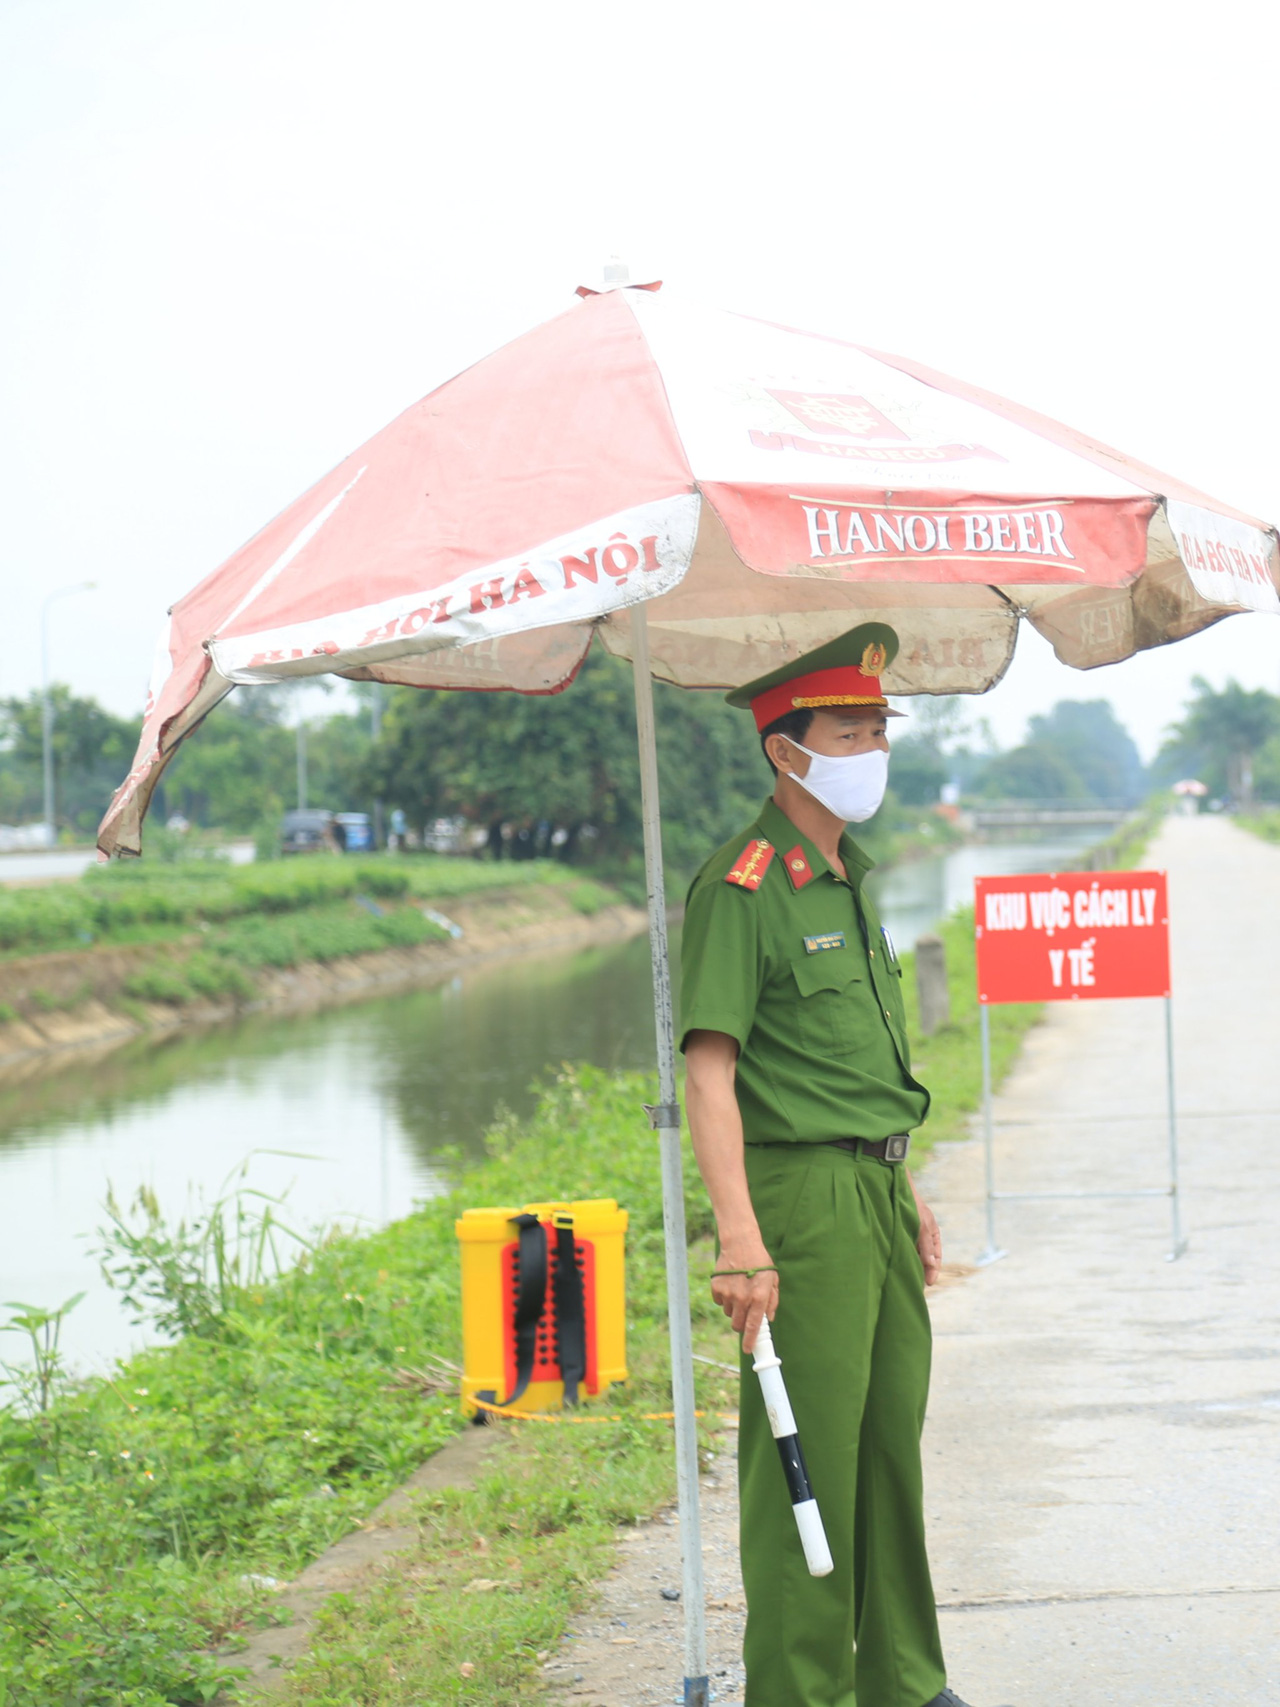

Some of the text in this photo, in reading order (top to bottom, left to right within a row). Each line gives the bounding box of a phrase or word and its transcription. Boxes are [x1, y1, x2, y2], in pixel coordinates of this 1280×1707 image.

[819, 444, 946, 461] HABECO
[802, 505, 1077, 560] HANOI BEER
[559, 531, 662, 590] NỘI
[985, 881, 1157, 937] KHU VỰC CÁCH LY
[1048, 937, 1096, 987] Y TẾ
